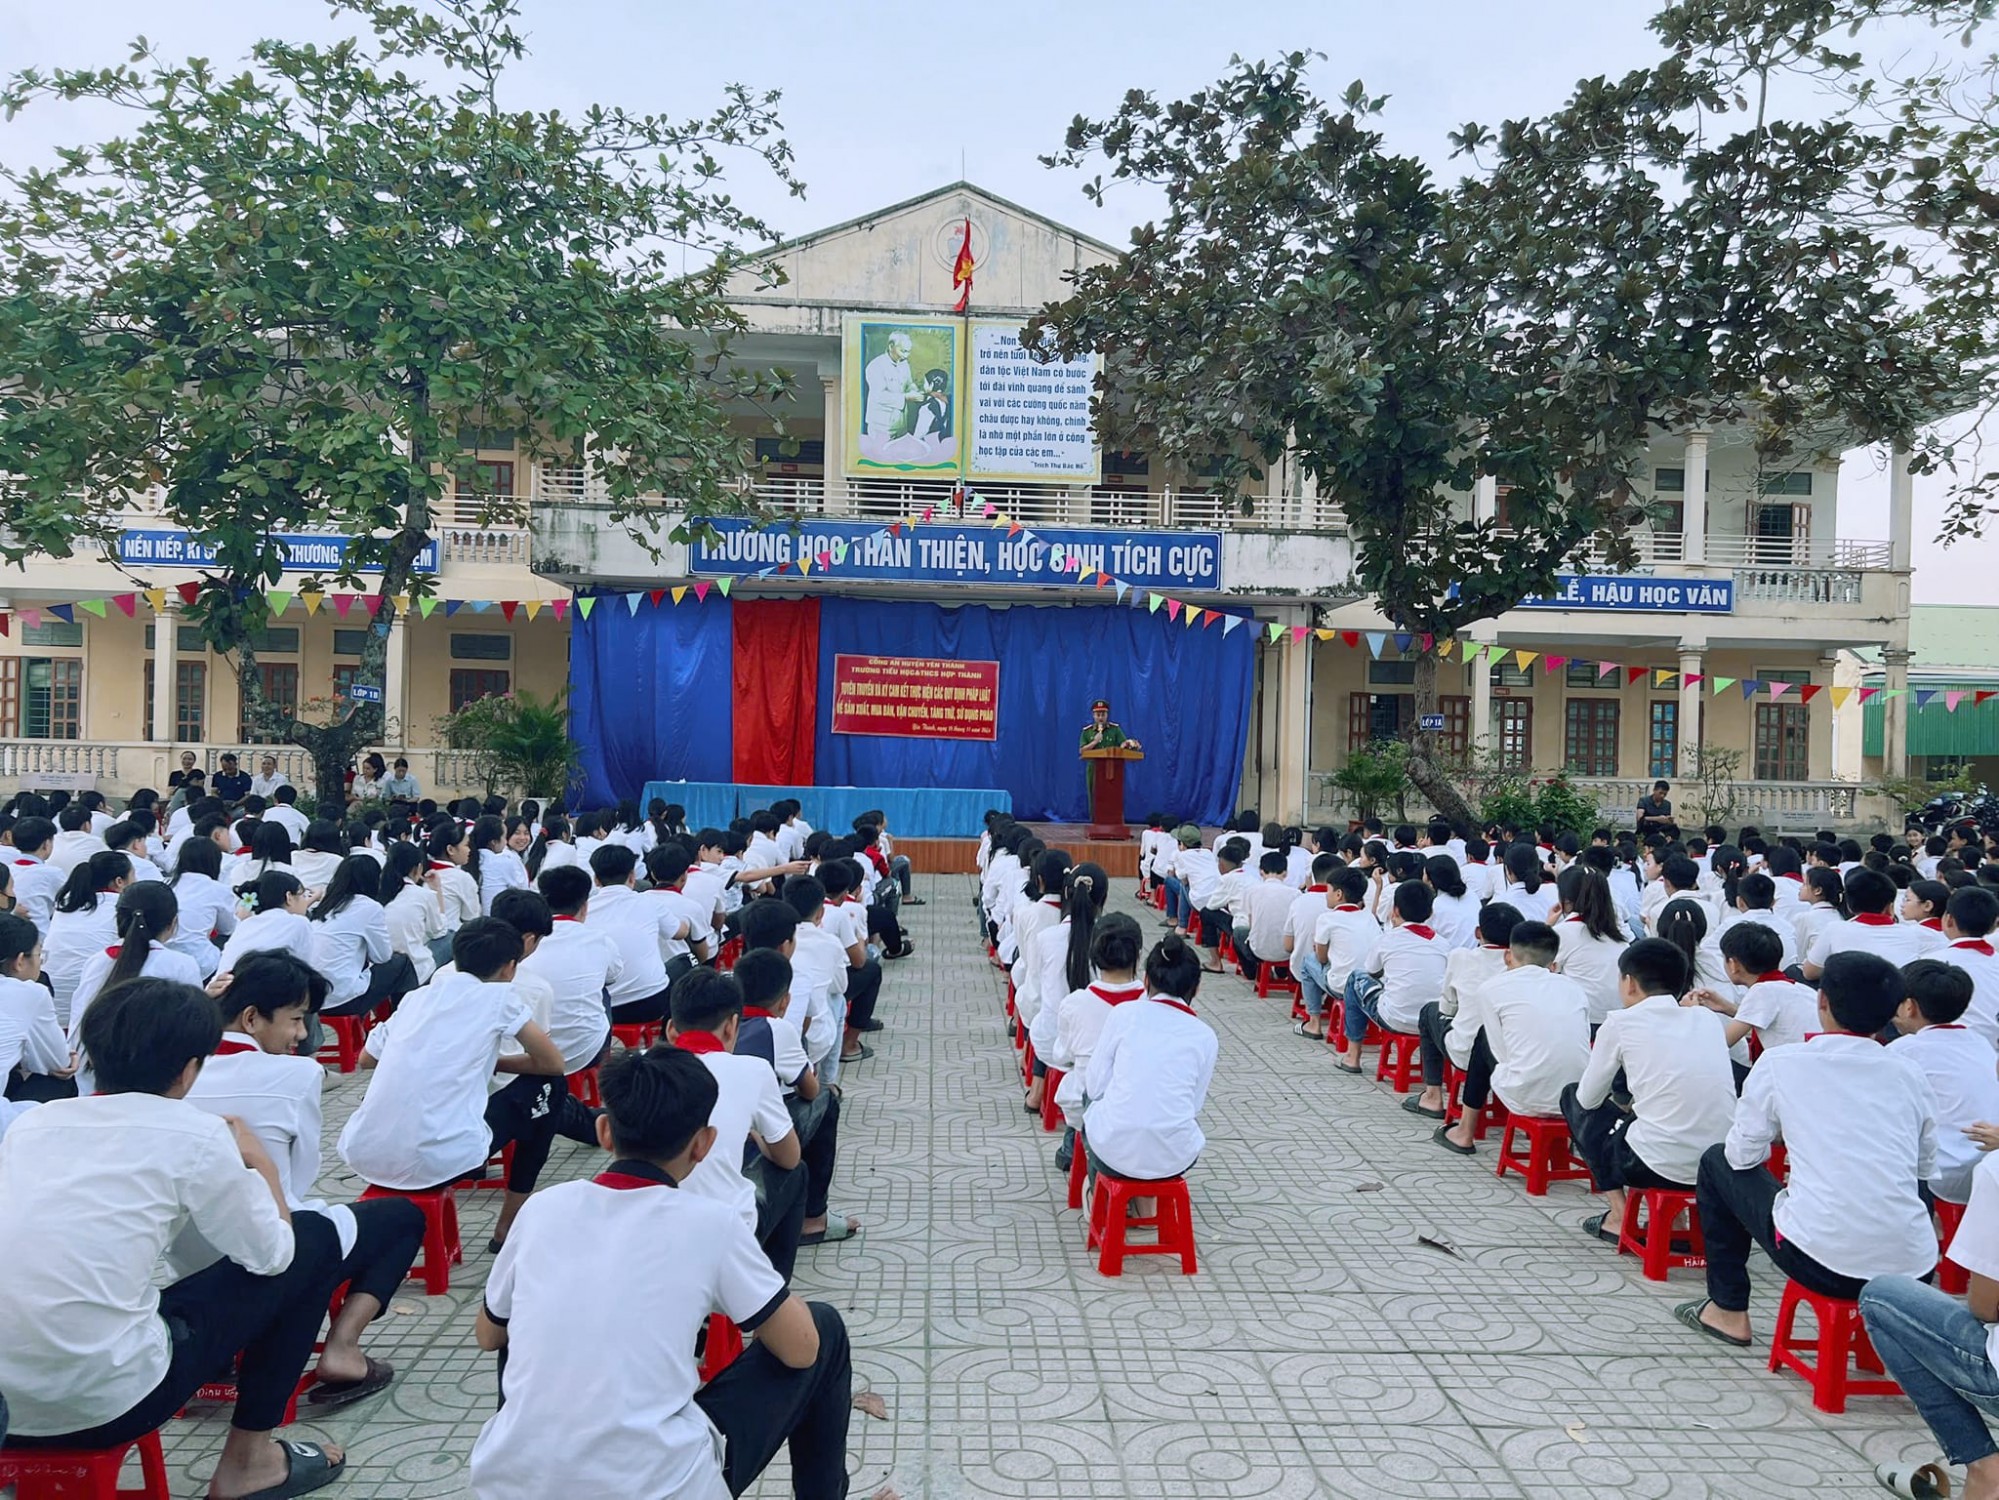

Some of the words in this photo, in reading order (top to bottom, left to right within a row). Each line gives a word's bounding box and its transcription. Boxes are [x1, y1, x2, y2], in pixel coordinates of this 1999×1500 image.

[994, 349, 1008, 360] nên
[980, 365, 995, 376] dân
[998, 366, 1011, 378] tộc
[1013, 366, 1029, 379] Việt
[1031, 367, 1050, 378] Nam
[1053, 367, 1063, 378] có
[1066, 367, 1086, 379] bước
[980, 381, 990, 391] tới
[992, 381, 1005, 392] đài
[1008, 382, 1025, 393] vinh
[1027, 384, 1052, 395] quang
[1054, 381, 1065, 394] để
[1067, 384, 1086, 395] sánh
[979, 398, 991, 408] vai
[993, 398, 1005, 408] với
[1007, 399, 1021, 409] các
[1048, 398, 1068, 411] quốc
[979, 414, 998, 424] châu
[1000, 414, 1019, 426] được
[1021, 415, 1035, 426] hay
[1065, 416, 1086, 427] chính
[979, 429, 987, 440] là
[1006, 430, 1021, 442] một
[1066, 432, 1085, 444] công
[979, 446, 993, 458] học
[995, 446, 1007, 458] tập
[1009, 445, 1023, 457] của
[1025, 447, 1040, 457] các
[125, 534, 153, 558] NỀN
[155, 535, 184, 560] NẾP,
[289, 544, 342, 566] THƯƠNG,
[701, 525, 791, 563] TRƯỜNG
[798, 535, 845, 571] HỌC
[851, 531, 912, 567] THÂN
[918, 534, 991, 576] THIỆN,
[998, 541, 1043, 577] HỌC
[1050, 543, 1105, 573] SINH
[1111, 540, 1162, 576] TÍCH
[1168, 544, 1213, 583] CỰC
[1592, 582, 1632, 606] HẬU
[1639, 586, 1680, 608] HỌC
[1686, 584, 1727, 606] VĂN
[353, 688, 367, 697] LỚP
